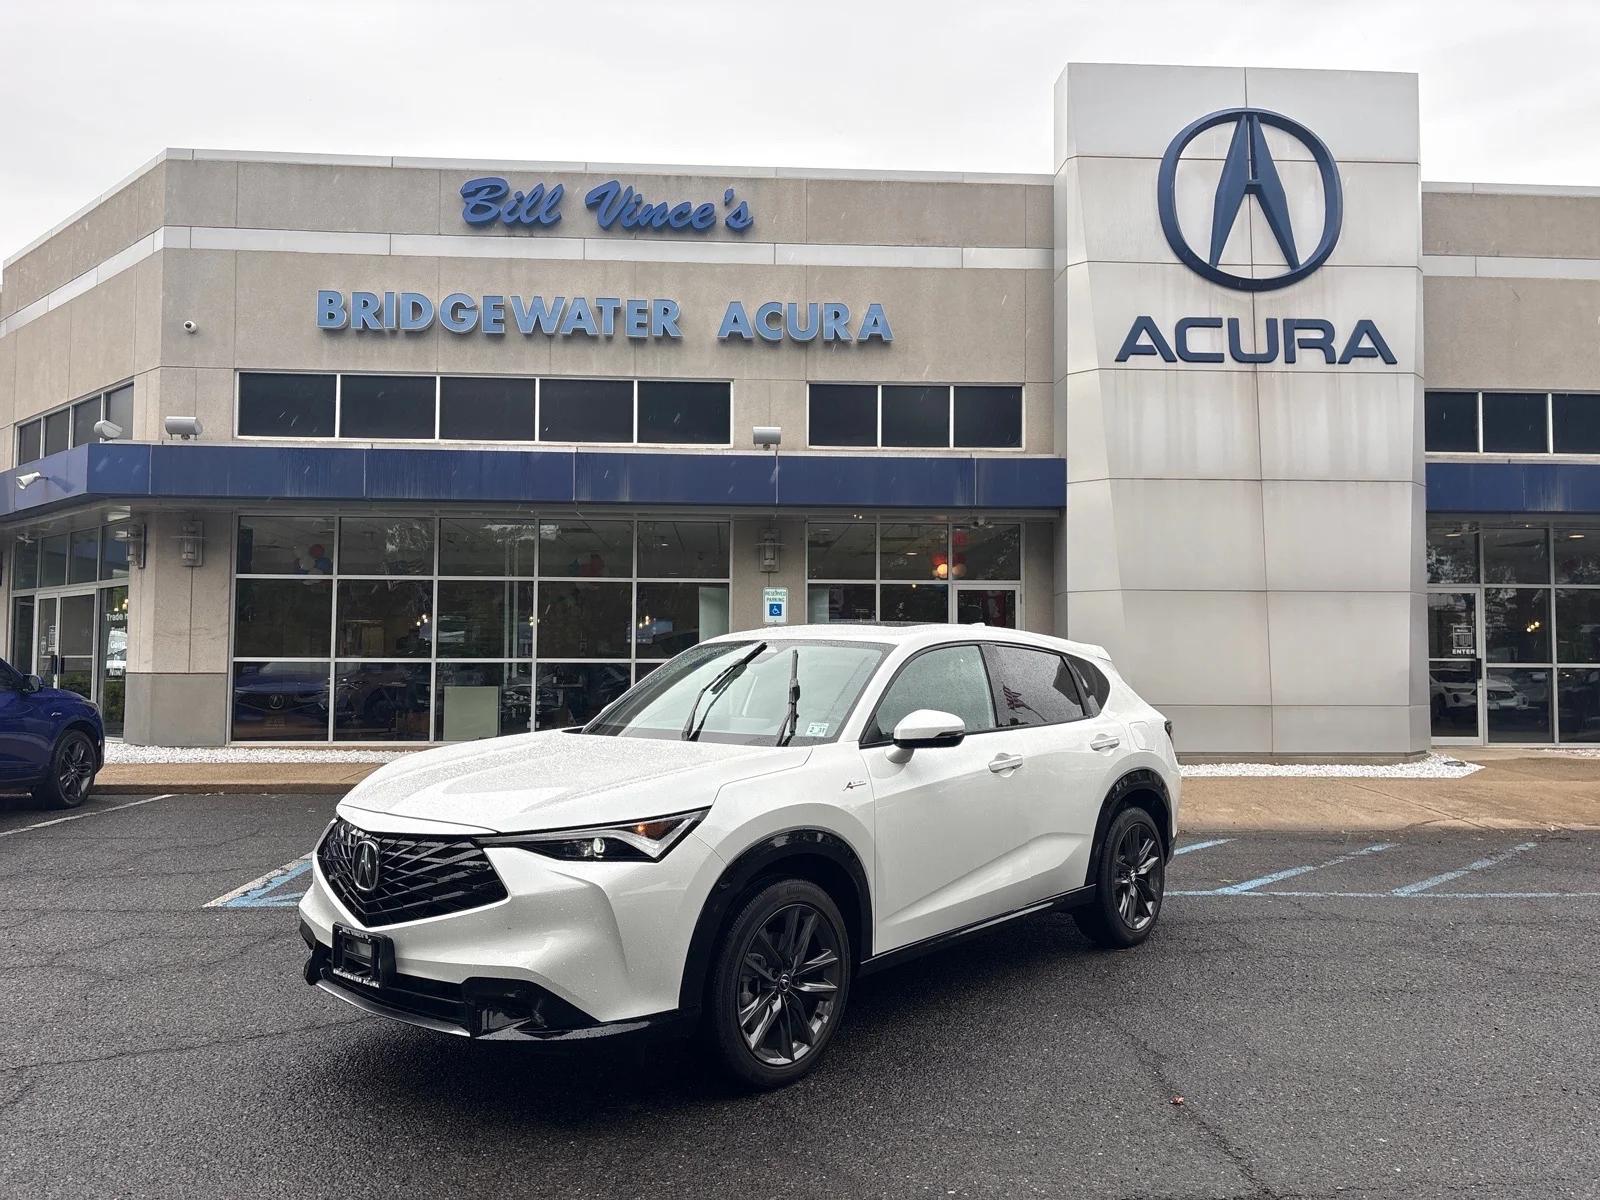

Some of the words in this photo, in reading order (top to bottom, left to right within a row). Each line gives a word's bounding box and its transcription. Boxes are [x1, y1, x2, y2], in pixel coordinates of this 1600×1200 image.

[459, 176, 565, 227] Bill
[584, 179, 754, 232] Vince's
[316, 290, 683, 339] BRIDGEWATER
[717, 301, 894, 342] ACURA
[1114, 315, 1398, 365] ACURA
[106, 613, 123, 621] Trade
